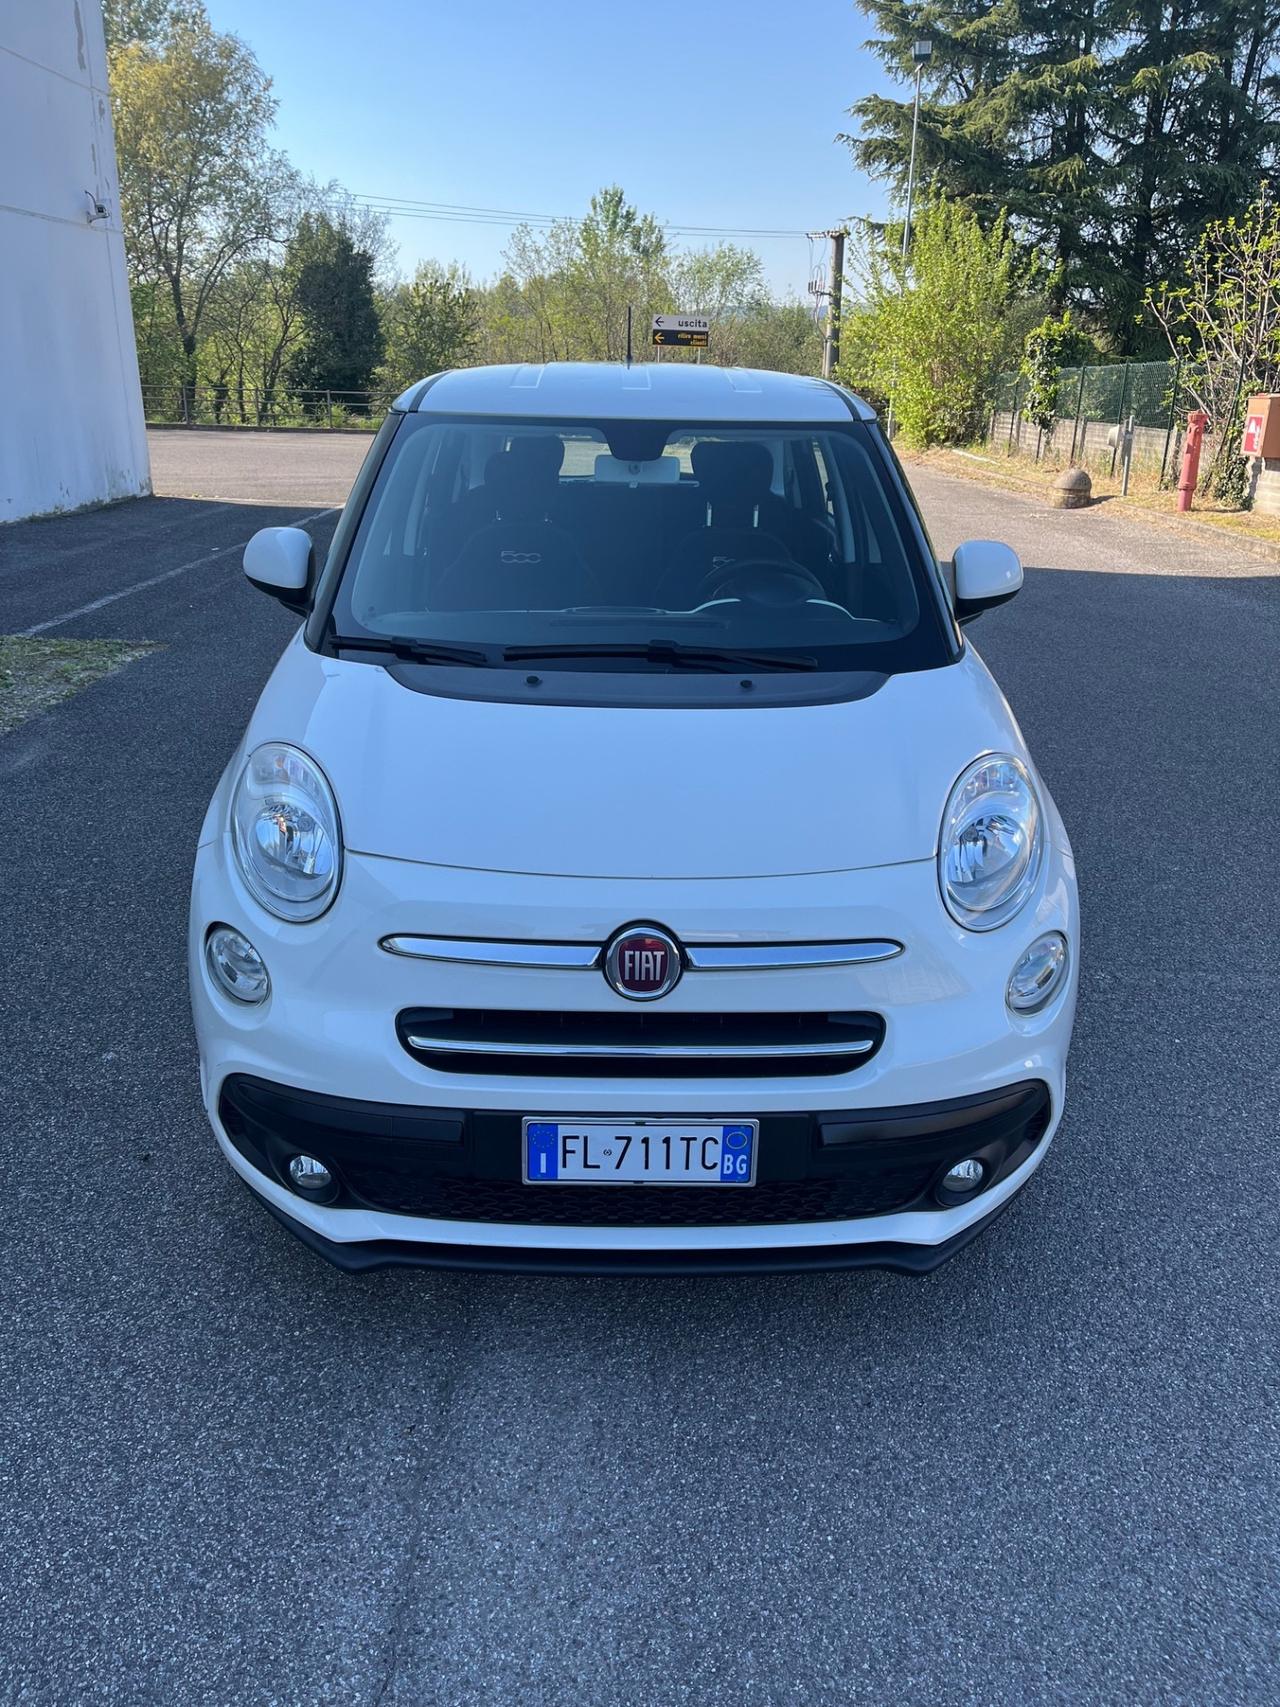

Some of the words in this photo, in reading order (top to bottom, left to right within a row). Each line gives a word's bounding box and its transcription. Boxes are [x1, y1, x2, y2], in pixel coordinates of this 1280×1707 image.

[678, 319, 708, 328] uscita
[501, 550, 541, 564] 500
[624, 950, 665, 981] FIAT
[723, 1154, 748, 1175] BG
